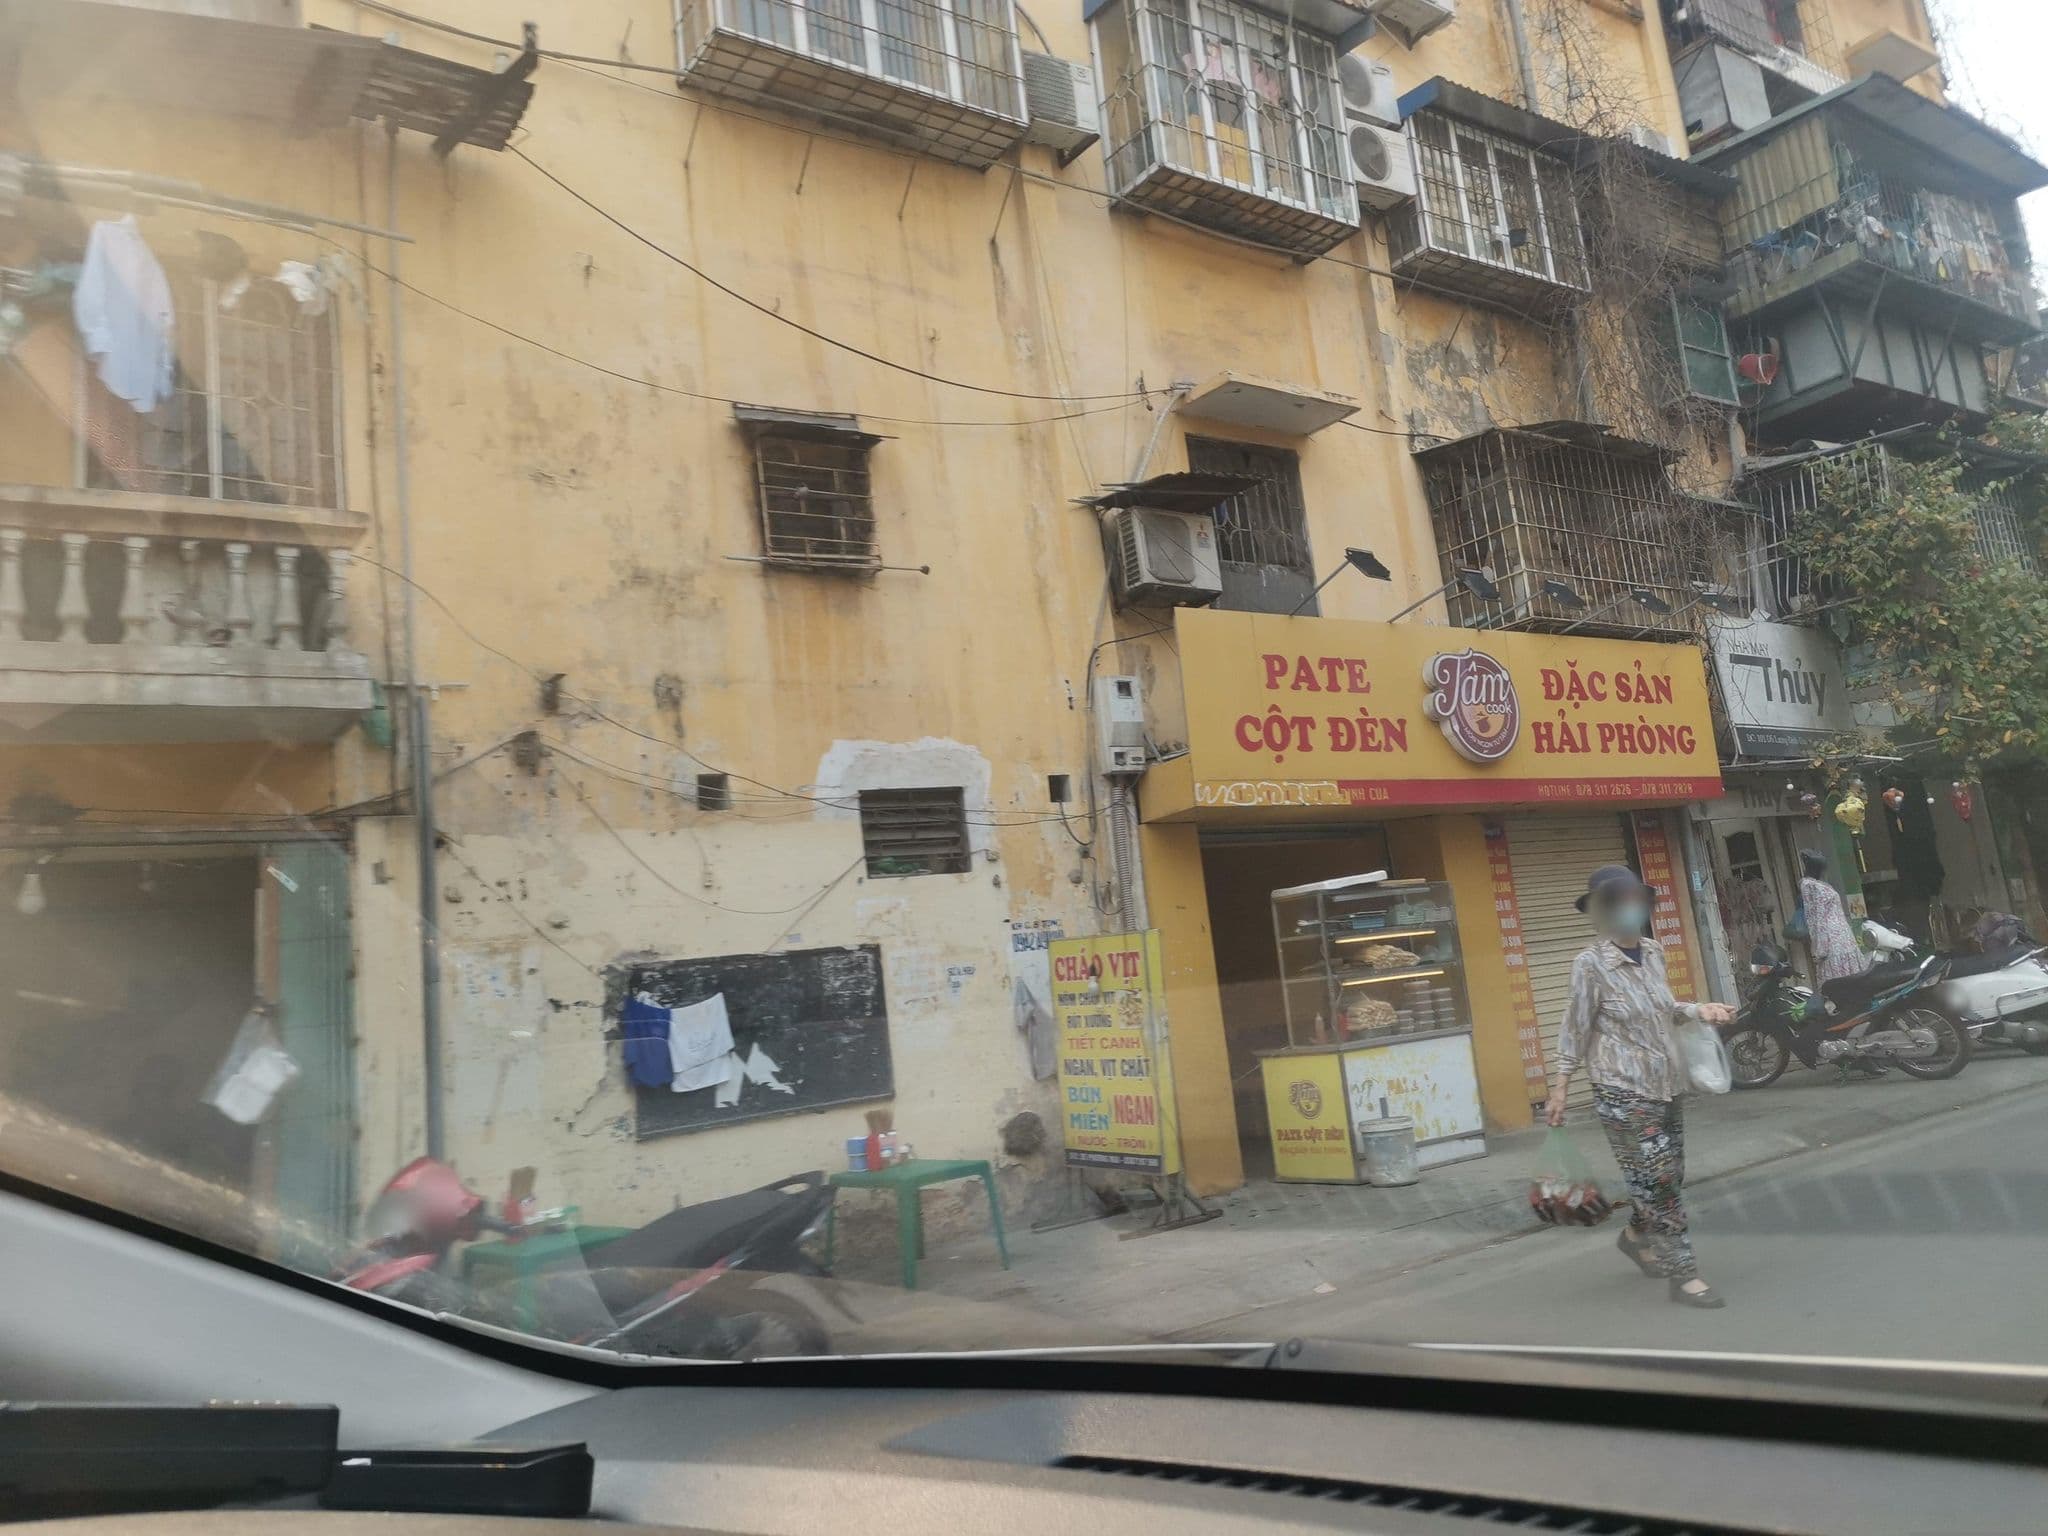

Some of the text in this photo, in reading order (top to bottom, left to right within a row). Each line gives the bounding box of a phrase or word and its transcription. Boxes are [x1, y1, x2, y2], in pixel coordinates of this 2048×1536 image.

[1261, 654, 1371, 694] PATE
[1434, 648, 1511, 716] Tâm
[1540, 659, 1673, 709] ĐẶC SẢN
[1729, 654, 1826, 717] Thủy
[1486, 700, 1513, 714] cook
[1235, 704, 1408, 763] CỘT ĐÈN
[1531, 708, 1696, 755] HẢI PHÒNG
[1055, 948, 1140, 984] CHÁO VỊT
[1067, 1033, 1140, 1049] TIẾT CANH
[1101, 1058, 1116, 1080] VỊT
[1120, 1055, 1151, 1081] CHẶT
[1068, 1083, 1102, 1104] BÚN
[1114, 1094, 1154, 1125] NGAN
[1070, 1106, 1109, 1131] MIẾN
